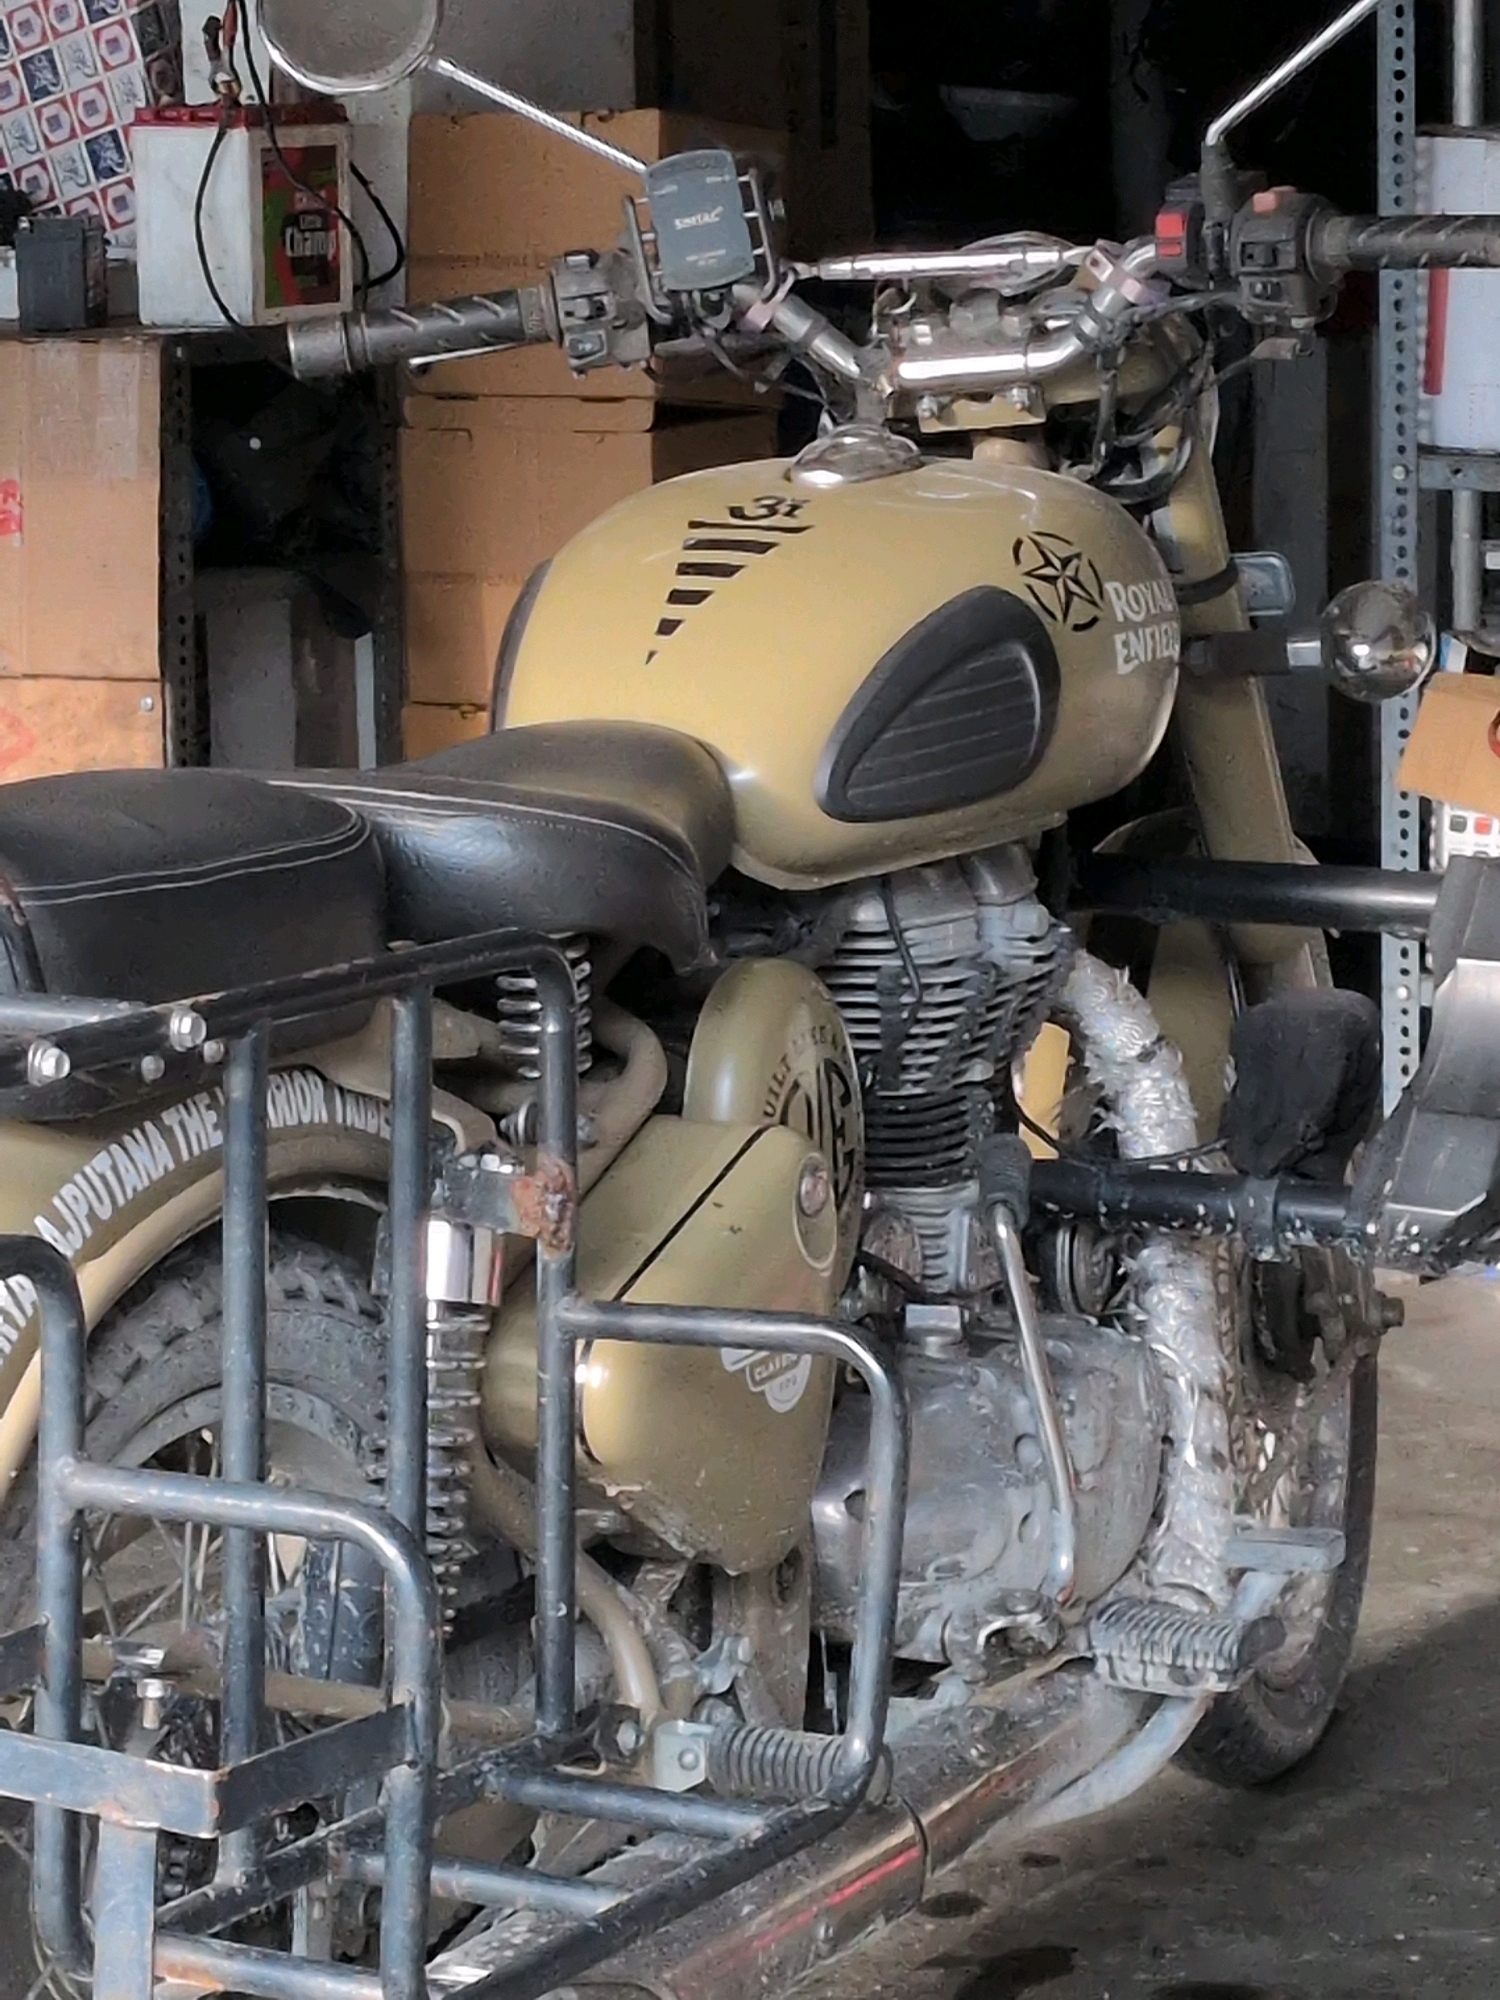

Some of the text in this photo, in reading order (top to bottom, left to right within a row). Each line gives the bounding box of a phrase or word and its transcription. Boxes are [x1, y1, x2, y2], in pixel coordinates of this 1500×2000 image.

[763, 1053, 792, 1118] UILT
[33, 1121, 176, 1259] AJPUTANA
[160, 1092, 223, 1162] THE
